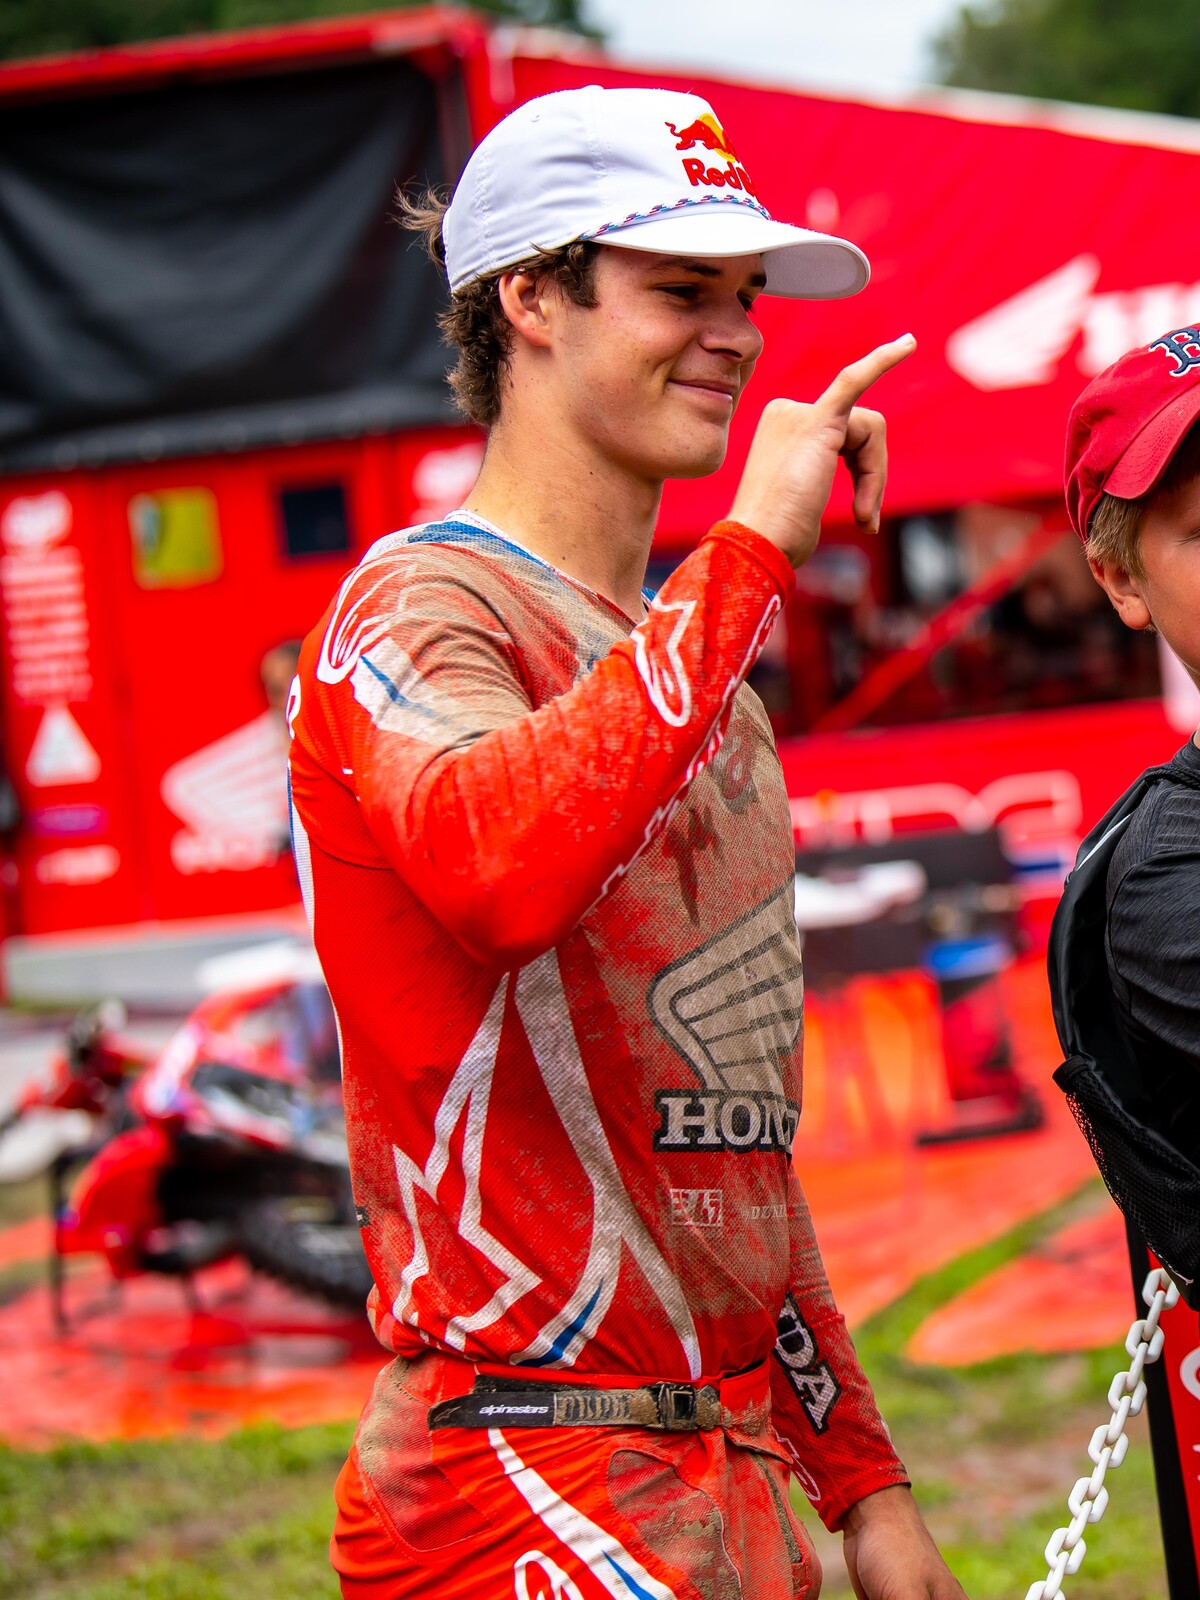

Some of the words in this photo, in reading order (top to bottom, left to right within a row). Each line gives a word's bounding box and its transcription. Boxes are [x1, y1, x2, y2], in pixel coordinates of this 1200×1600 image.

[682, 157, 743, 191] Red
[656, 1093, 800, 1150] HON
[478, 1403, 550, 1417] alpinestars
